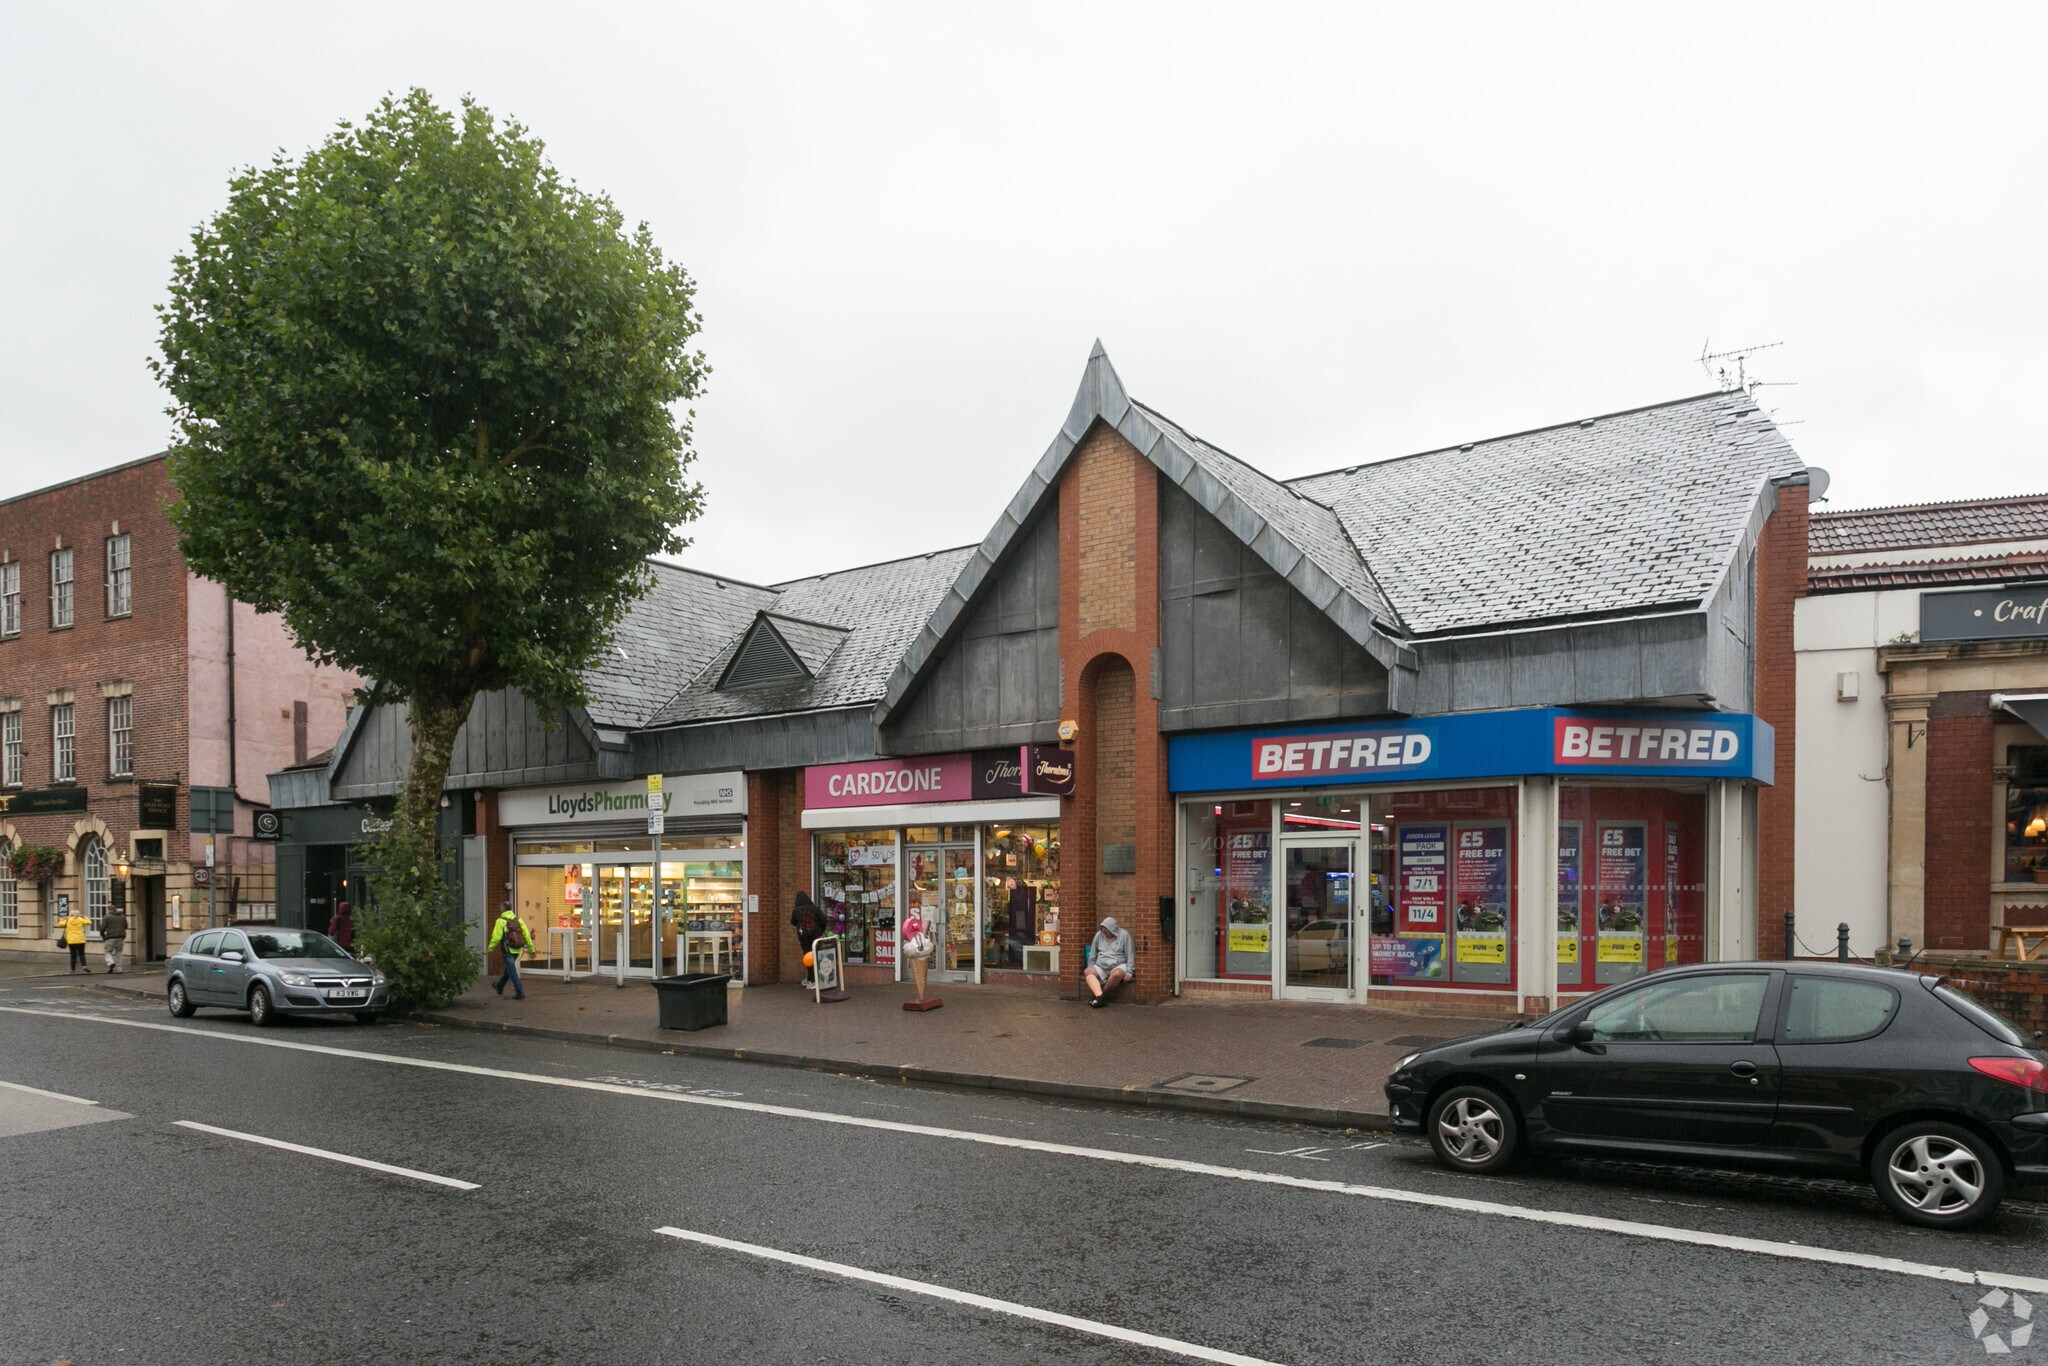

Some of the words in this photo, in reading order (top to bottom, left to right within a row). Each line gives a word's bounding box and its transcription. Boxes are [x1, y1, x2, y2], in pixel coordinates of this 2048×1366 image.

[1561, 726, 1739, 761] BETFRED
[1258, 734, 1432, 773] BETFRED
[986, 761, 1021, 783] Thor
[1036, 761, 1070, 777] Thorntons
[828, 767, 942, 797] CARDZONE
[719, 788, 733, 797] NHS
[549, 791, 672, 819] LloydsPharmy
[1461, 831, 1483, 847] £5
[1603, 830, 1623, 845] £5
[1253, 850, 1267, 858] BET
[1460, 849, 1483, 858] FREE
[1485, 849, 1503, 857] BET
[1560, 848, 1576, 857] BET
[1602, 848, 1623, 856] FREE
[1625, 848, 1641, 856] BET
[1416, 879, 1432, 888] 7/1
[1412, 909, 1434, 919] 11/4
